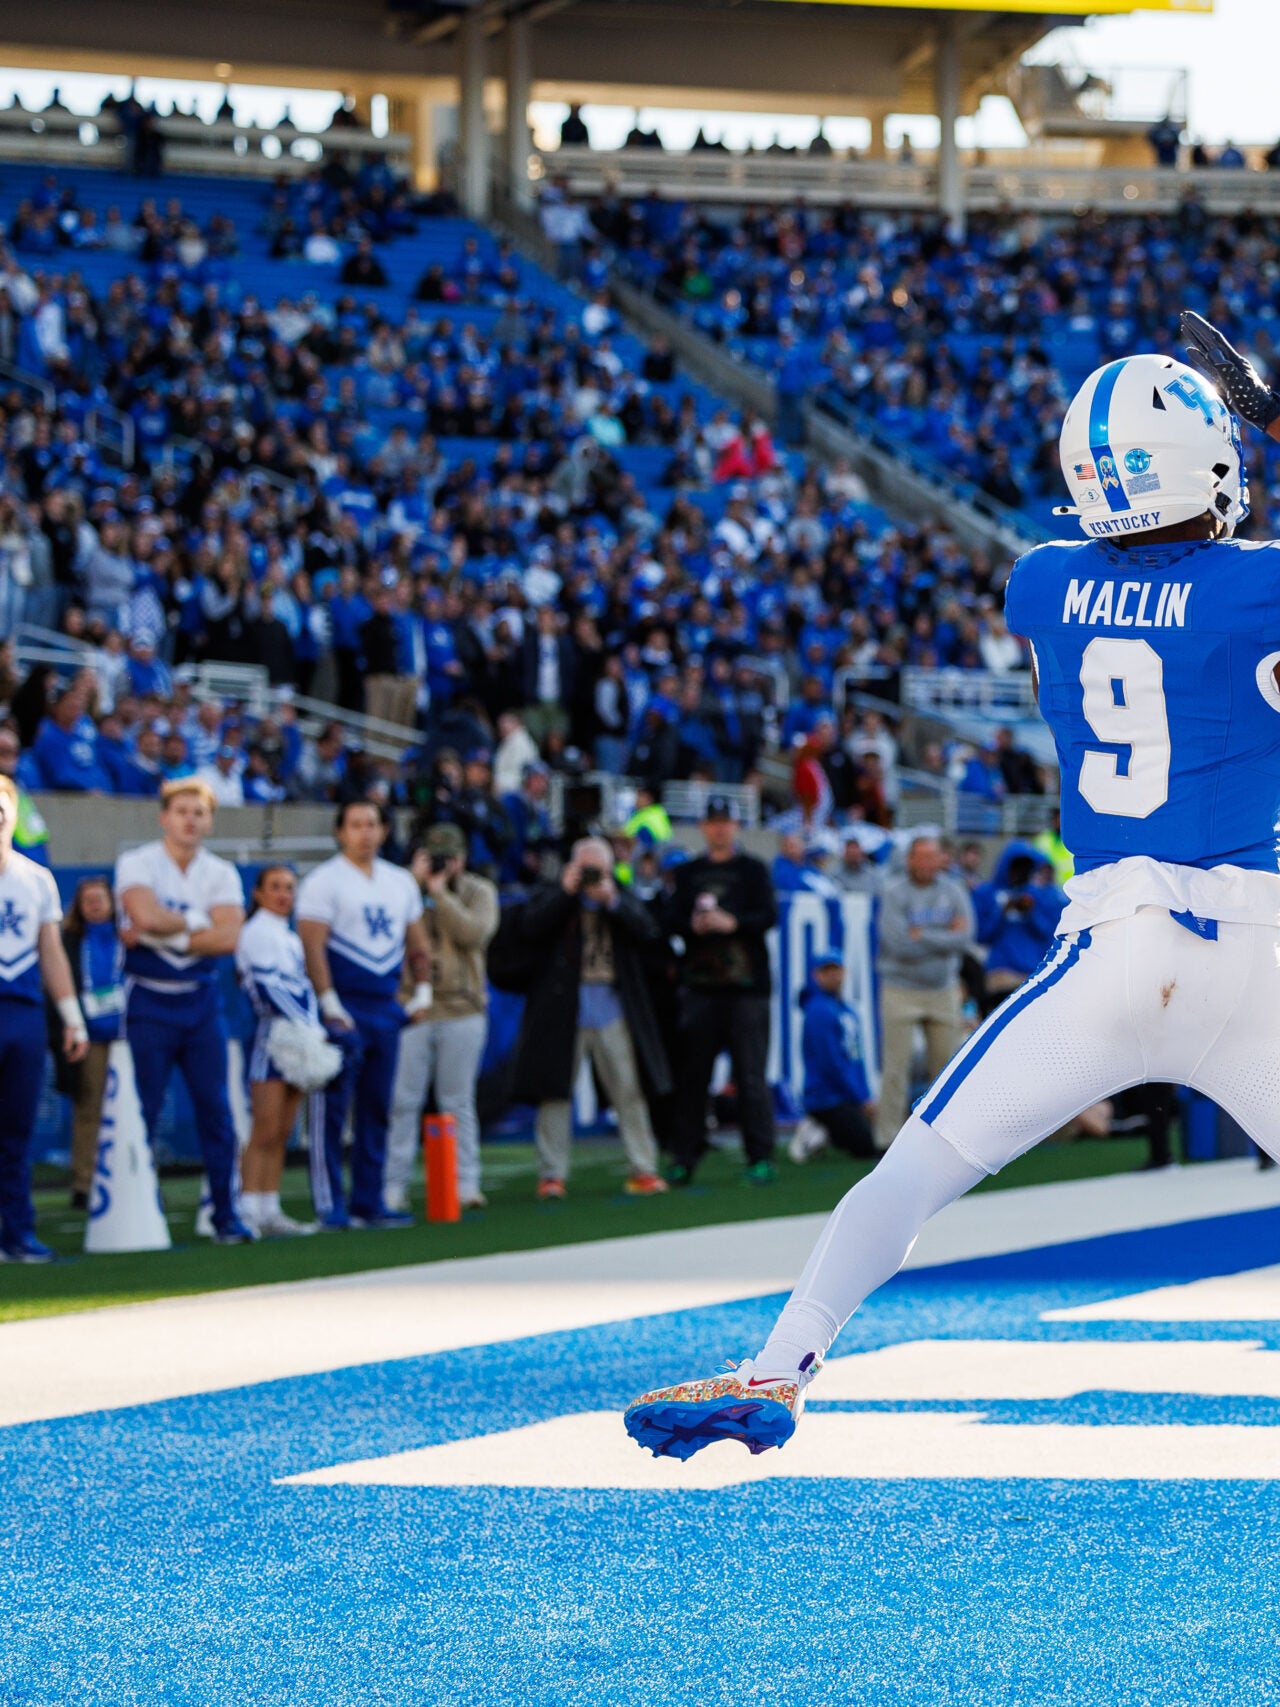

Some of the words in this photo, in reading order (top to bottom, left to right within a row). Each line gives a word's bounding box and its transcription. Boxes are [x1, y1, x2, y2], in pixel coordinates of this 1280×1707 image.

[1089, 511, 1161, 535] KENTUCKY
[1062, 578, 1193, 628] MACLIN
[1078, 636, 1171, 819] 9
